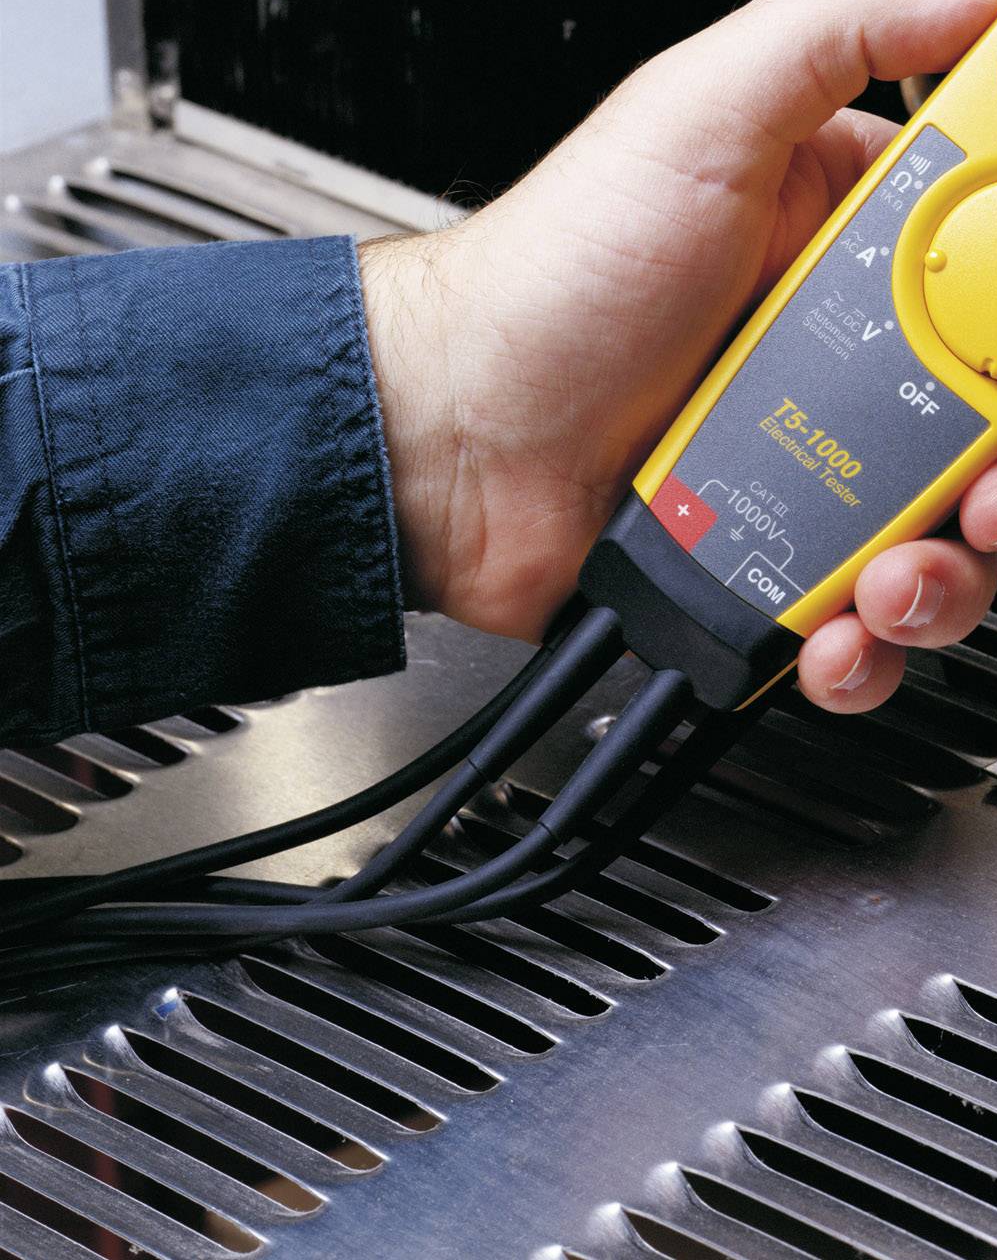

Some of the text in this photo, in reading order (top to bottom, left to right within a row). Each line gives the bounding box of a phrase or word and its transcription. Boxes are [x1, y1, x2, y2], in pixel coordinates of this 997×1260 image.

[856, 246, 878, 268] A
[802, 316, 850, 360] Selection
[809, 307, 858, 351] Automatic
[861, 321, 882, 343] V
[898, 381, 940, 417] OFF
[774, 397, 863, 479] T5-1000
[759, 417, 863, 508] Electrical Tester
[750, 481, 776, 504] CAT
[727, 488, 786, 541] 1000V
[747, 568, 786, 605] COM
